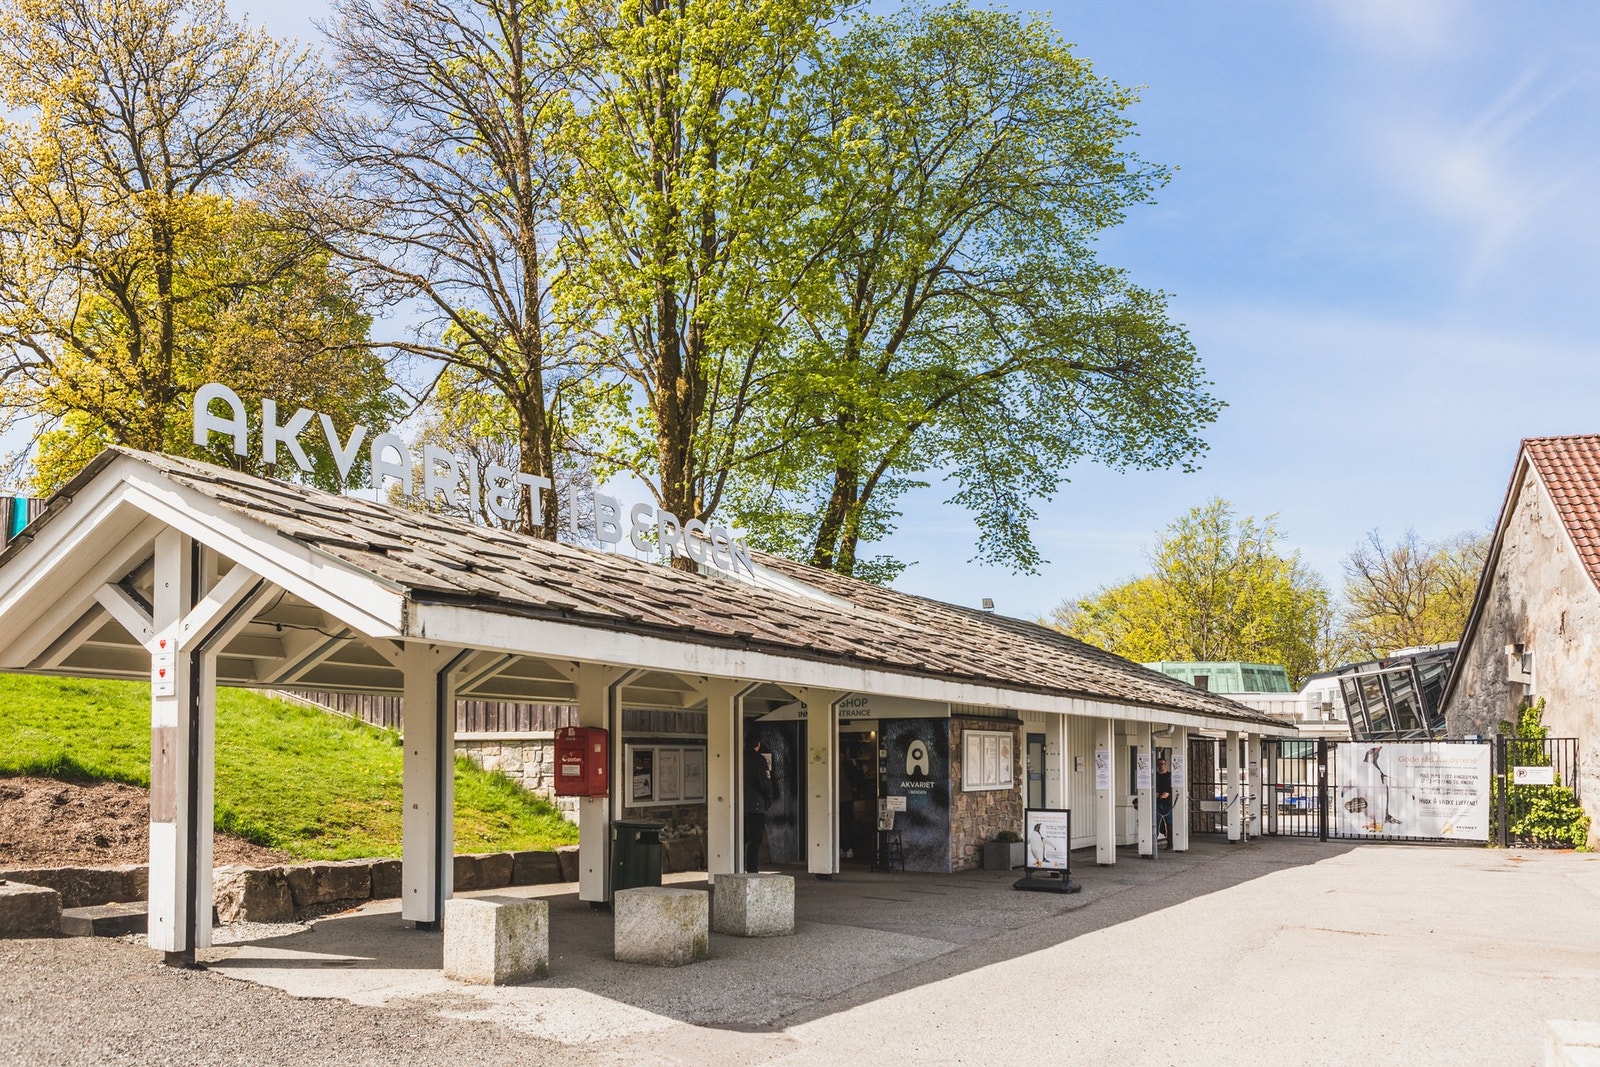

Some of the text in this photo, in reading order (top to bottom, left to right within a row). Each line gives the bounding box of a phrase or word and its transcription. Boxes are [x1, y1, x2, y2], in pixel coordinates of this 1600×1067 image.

[193, 383, 755, 578] AKVARIET I BERGEN
[840, 698, 868, 708] SHOP
[900, 781, 935, 789] AKVARIET
